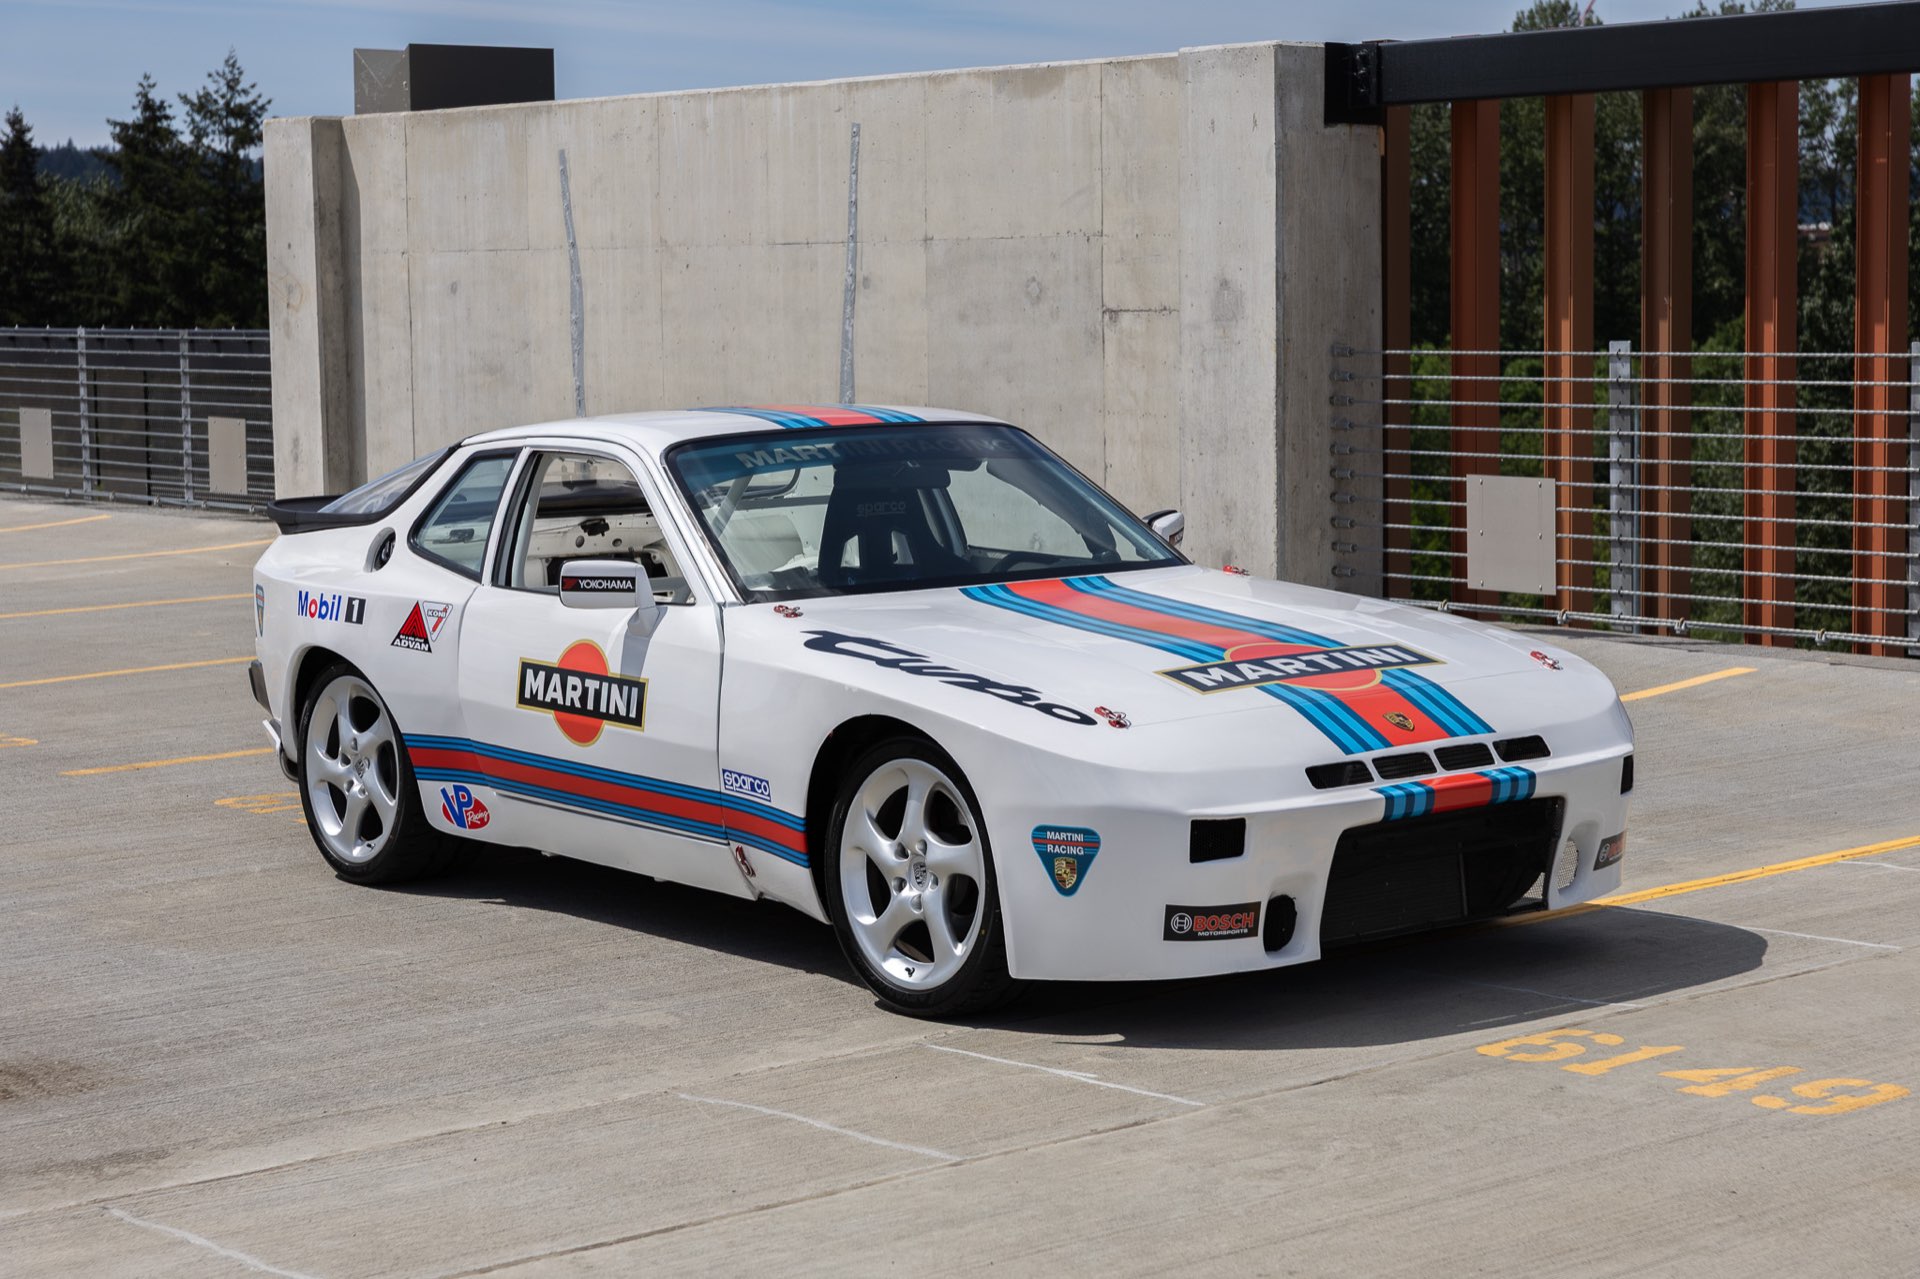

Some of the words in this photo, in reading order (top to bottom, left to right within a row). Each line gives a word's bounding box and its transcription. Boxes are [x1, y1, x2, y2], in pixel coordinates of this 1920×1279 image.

[578, 579, 633, 590] YOKOHAMA
[297, 590, 342, 621] Mobil
[427, 609, 447, 618] KONI
[393, 638, 429, 651] ADVAN
[1181, 646, 1419, 687] MARTINI
[524, 668, 639, 719] MARTINI
[723, 770, 770, 799] sparco
[440, 783, 474, 829] VP
[1046, 831, 1084, 842] MARTINI
[1047, 844, 1084, 856] RACING
[1193, 911, 1255, 932] BOSCH
[1197, 928, 1249, 937] MOTORSPORTS
